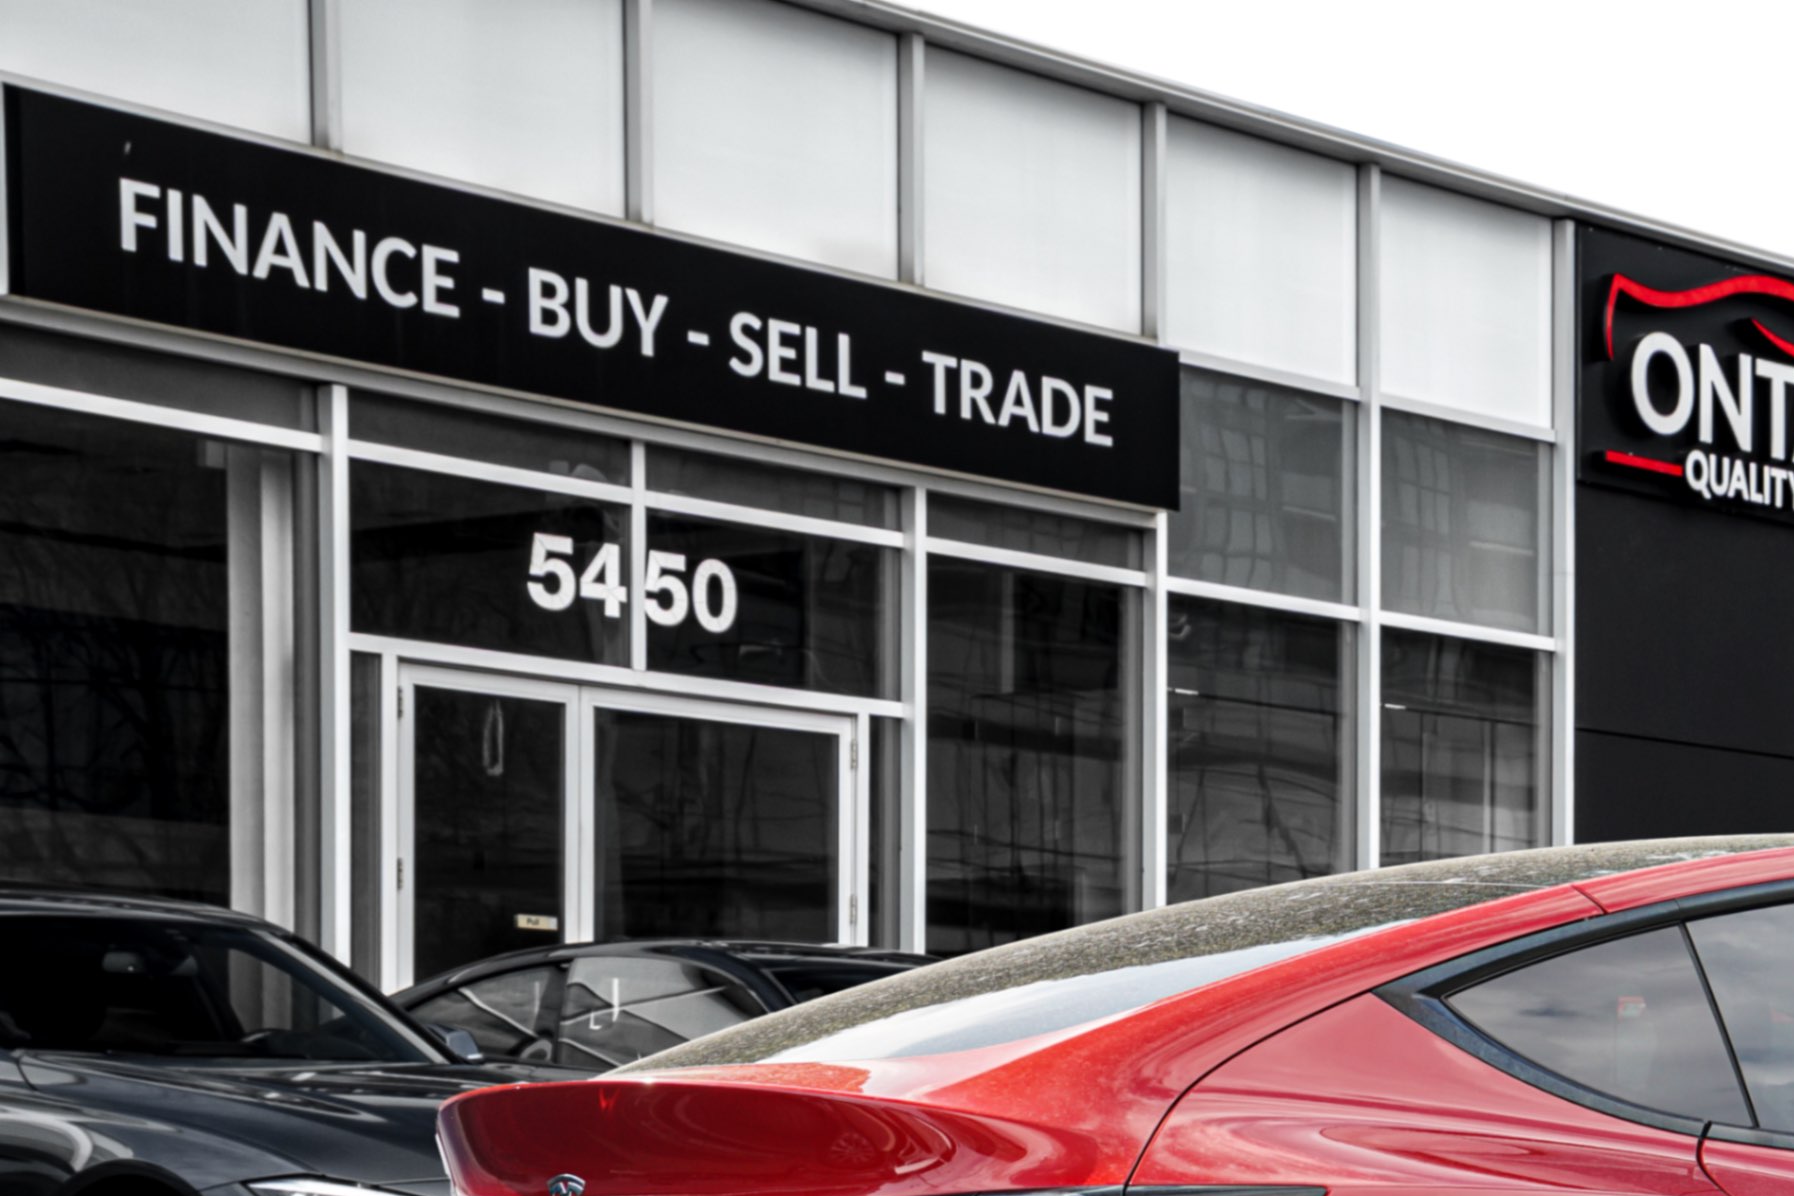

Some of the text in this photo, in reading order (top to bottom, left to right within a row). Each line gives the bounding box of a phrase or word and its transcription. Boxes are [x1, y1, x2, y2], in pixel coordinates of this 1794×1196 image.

[119, 178, 460, 318] FINANCE
[528, 267, 668, 357] BUY
[729, 312, 867, 399] SELL
[922, 350, 1113, 447] TRADE
[527, 533, 737, 633] 5450
